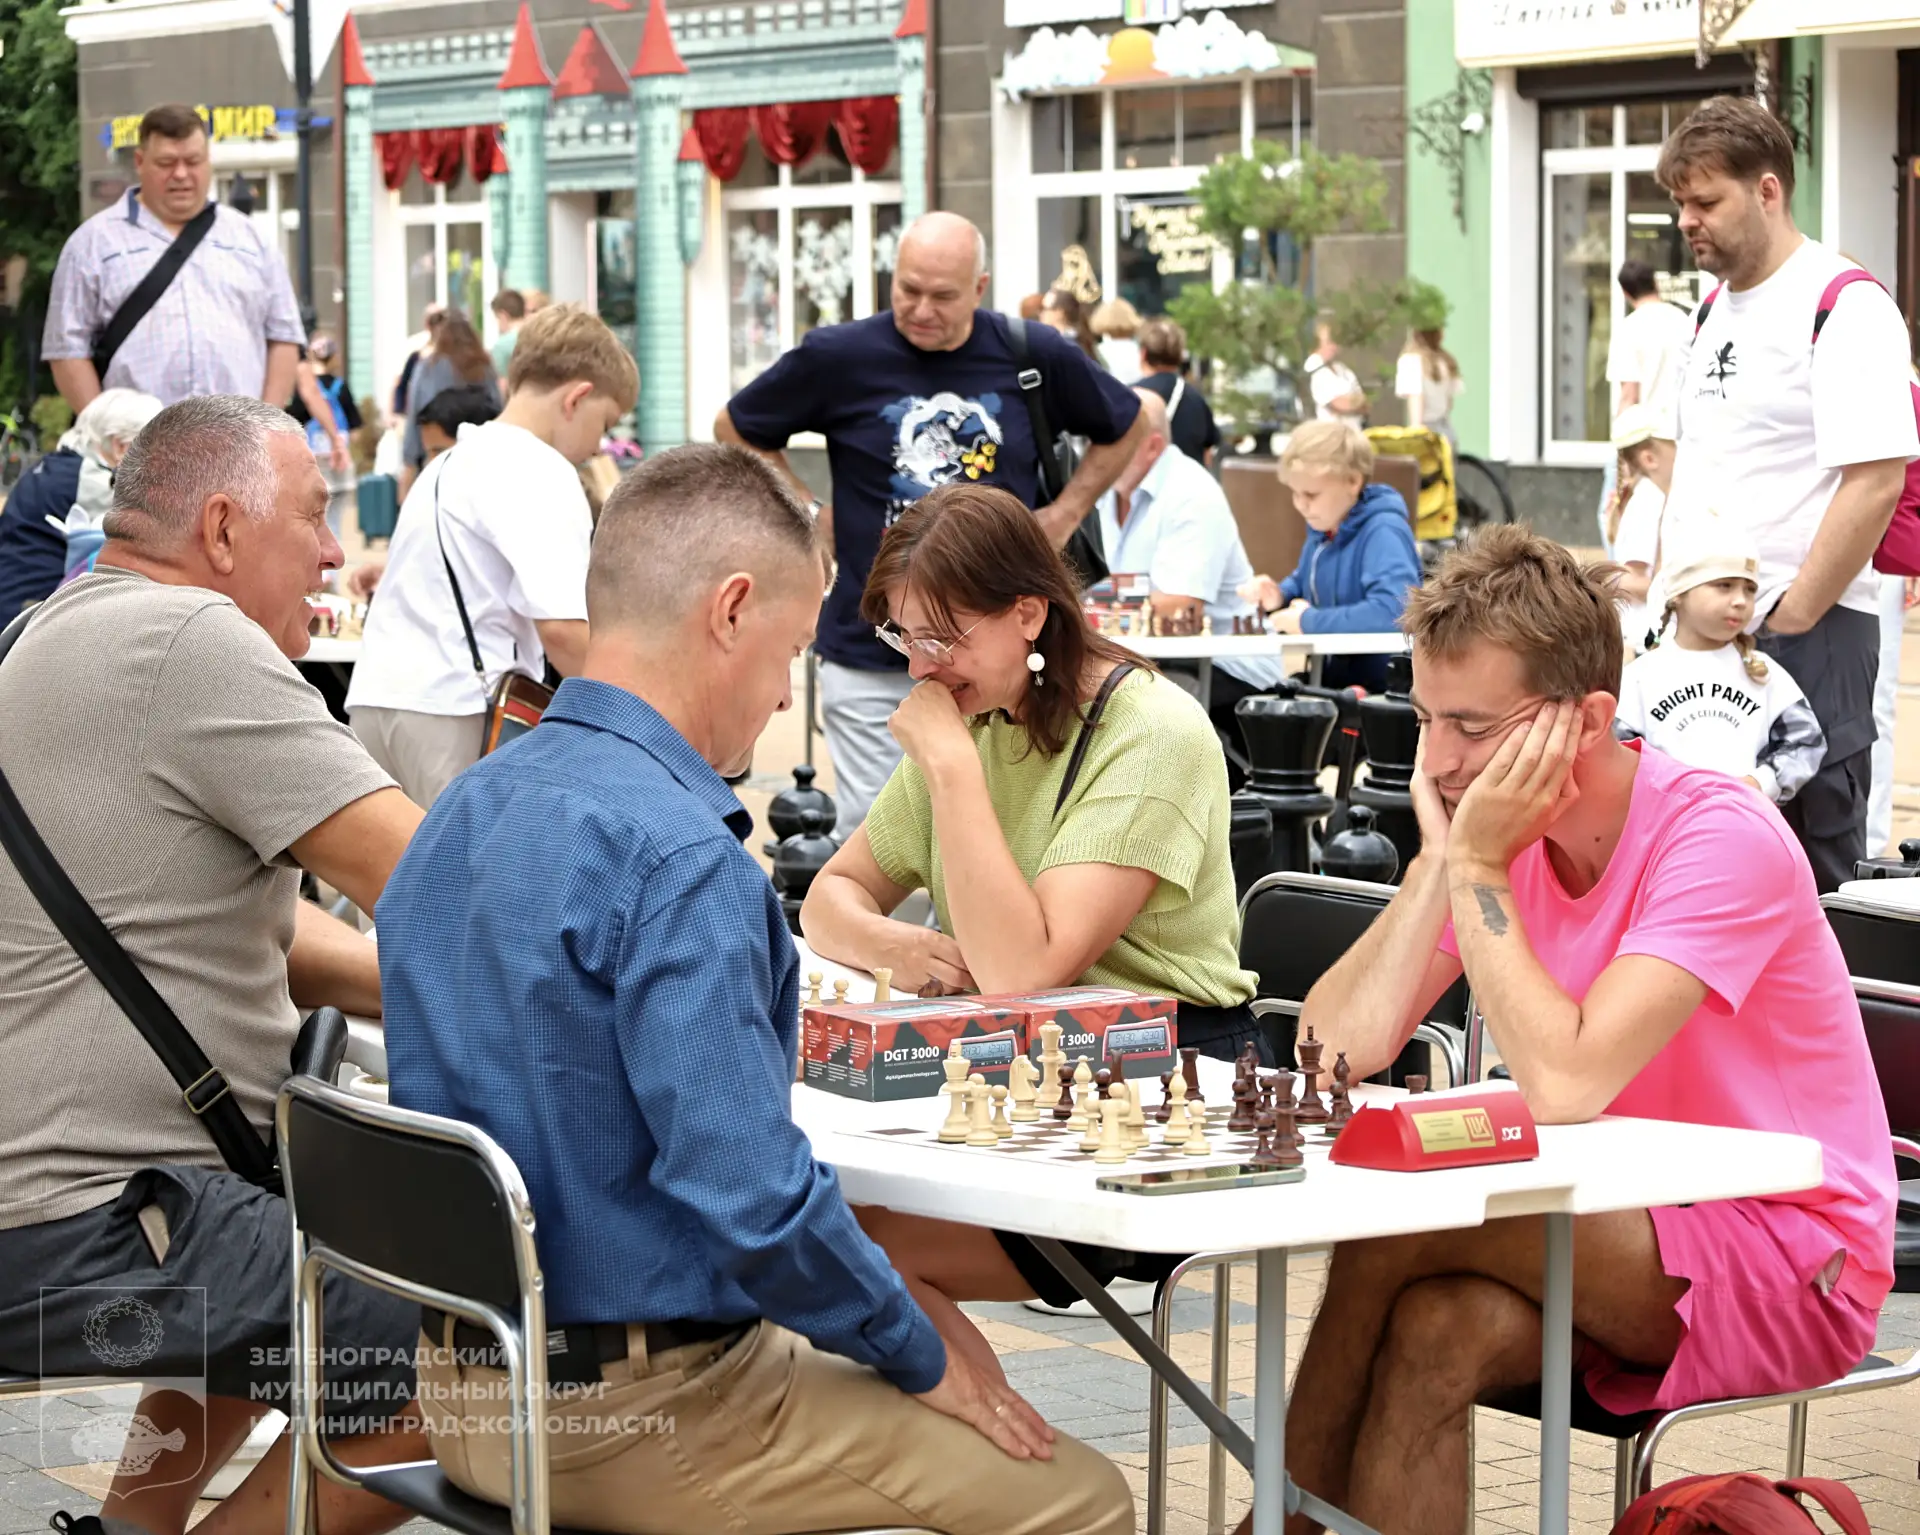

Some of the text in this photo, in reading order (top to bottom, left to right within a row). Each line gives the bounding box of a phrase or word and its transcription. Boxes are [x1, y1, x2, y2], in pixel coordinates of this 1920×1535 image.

[1650, 683, 1761, 722] BRIGHT PARTY
[1067, 1032, 1095, 1046] 3000
[883, 1048, 909, 1063] DGT
[911, 1045, 940, 1060] 3000
[1501, 1126, 1522, 1142] DGT
